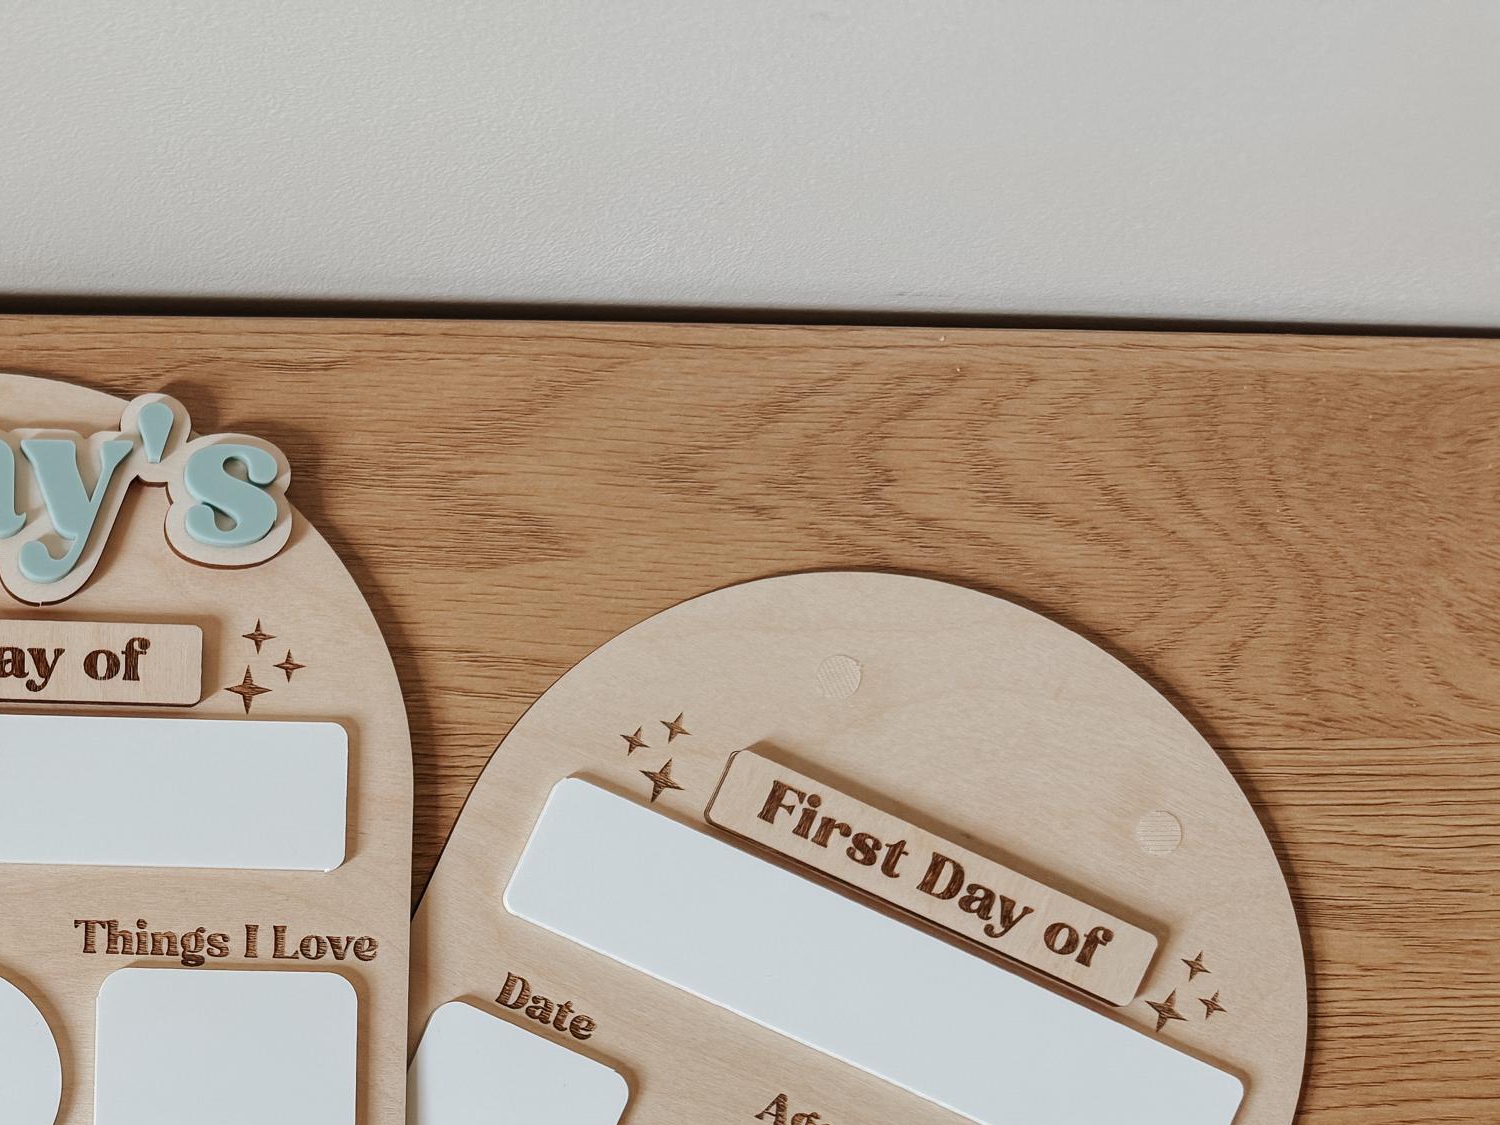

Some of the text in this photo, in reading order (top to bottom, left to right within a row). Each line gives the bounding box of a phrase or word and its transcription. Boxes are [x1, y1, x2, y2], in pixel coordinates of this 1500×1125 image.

[84, 637, 151, 683] of
[756, 778, 1114, 969] First Day of
[74, 918, 379, 967] Things I Love
[494, 971, 598, 1043] Date
